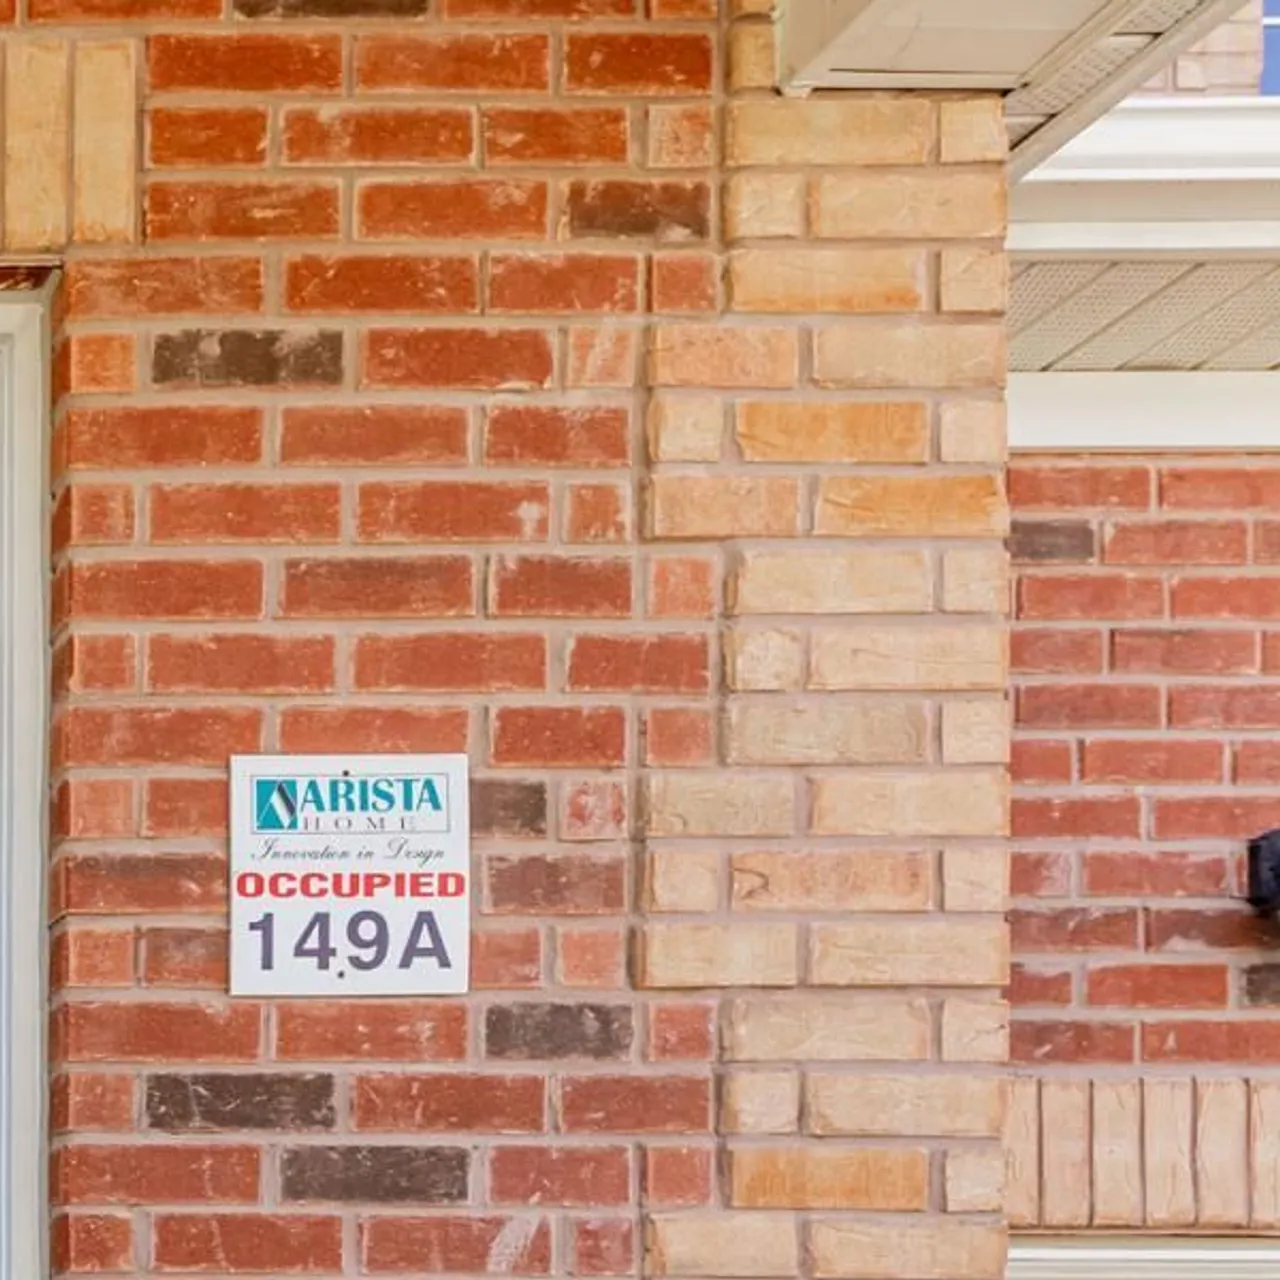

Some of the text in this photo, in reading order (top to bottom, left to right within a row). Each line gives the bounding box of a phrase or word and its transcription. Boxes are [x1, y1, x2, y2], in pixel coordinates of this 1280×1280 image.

[300, 777, 442, 812] ARISTA
[251, 836, 445, 867] Innovation in Design
[236, 872, 465, 898] OCCUPIED
[249, 910, 452, 971] 149A
